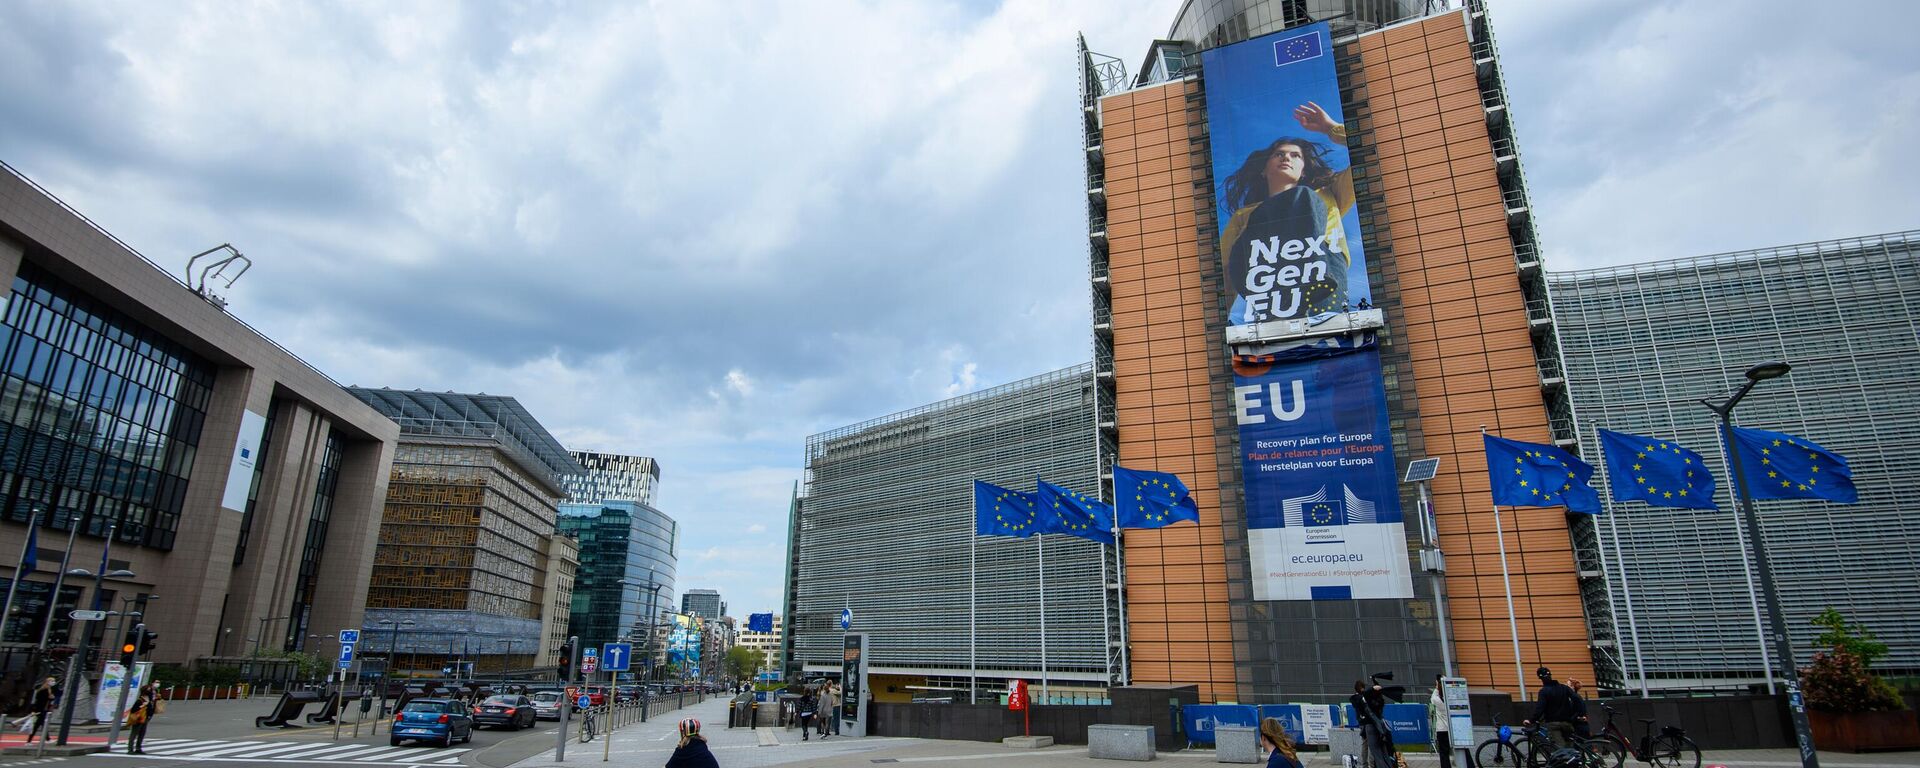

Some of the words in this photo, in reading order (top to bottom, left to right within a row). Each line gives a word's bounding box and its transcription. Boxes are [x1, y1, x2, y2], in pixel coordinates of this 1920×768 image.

[1249, 229, 1343, 267] Next
[1246, 260, 1327, 293] Gen
[1244, 287, 1302, 322] EU
[1235, 380, 1306, 425] EU
[1257, 439, 1297, 449] Recovery
[1300, 436, 1320, 447] plan
[1323, 435, 1337, 444] for
[1339, 433, 1372, 443] Europe
[1248, 452, 1268, 461] Plan
[1271, 450, 1281, 459] de
[1284, 448, 1319, 459] relance
[1321, 447, 1342, 457] pour
[1344, 443, 1384, 455] l'Europe
[1260, 461, 1313, 471] Herstelplan
[1316, 459, 1337, 468] voor
[1339, 457, 1374, 467] Europa
[1291, 553, 1364, 565] ec.europa.eu
[1270, 570, 1328, 578] #NextGenerationEU
[1333, 568, 1391, 578] #StrongerTogether
[342, 645, 352, 659] P
